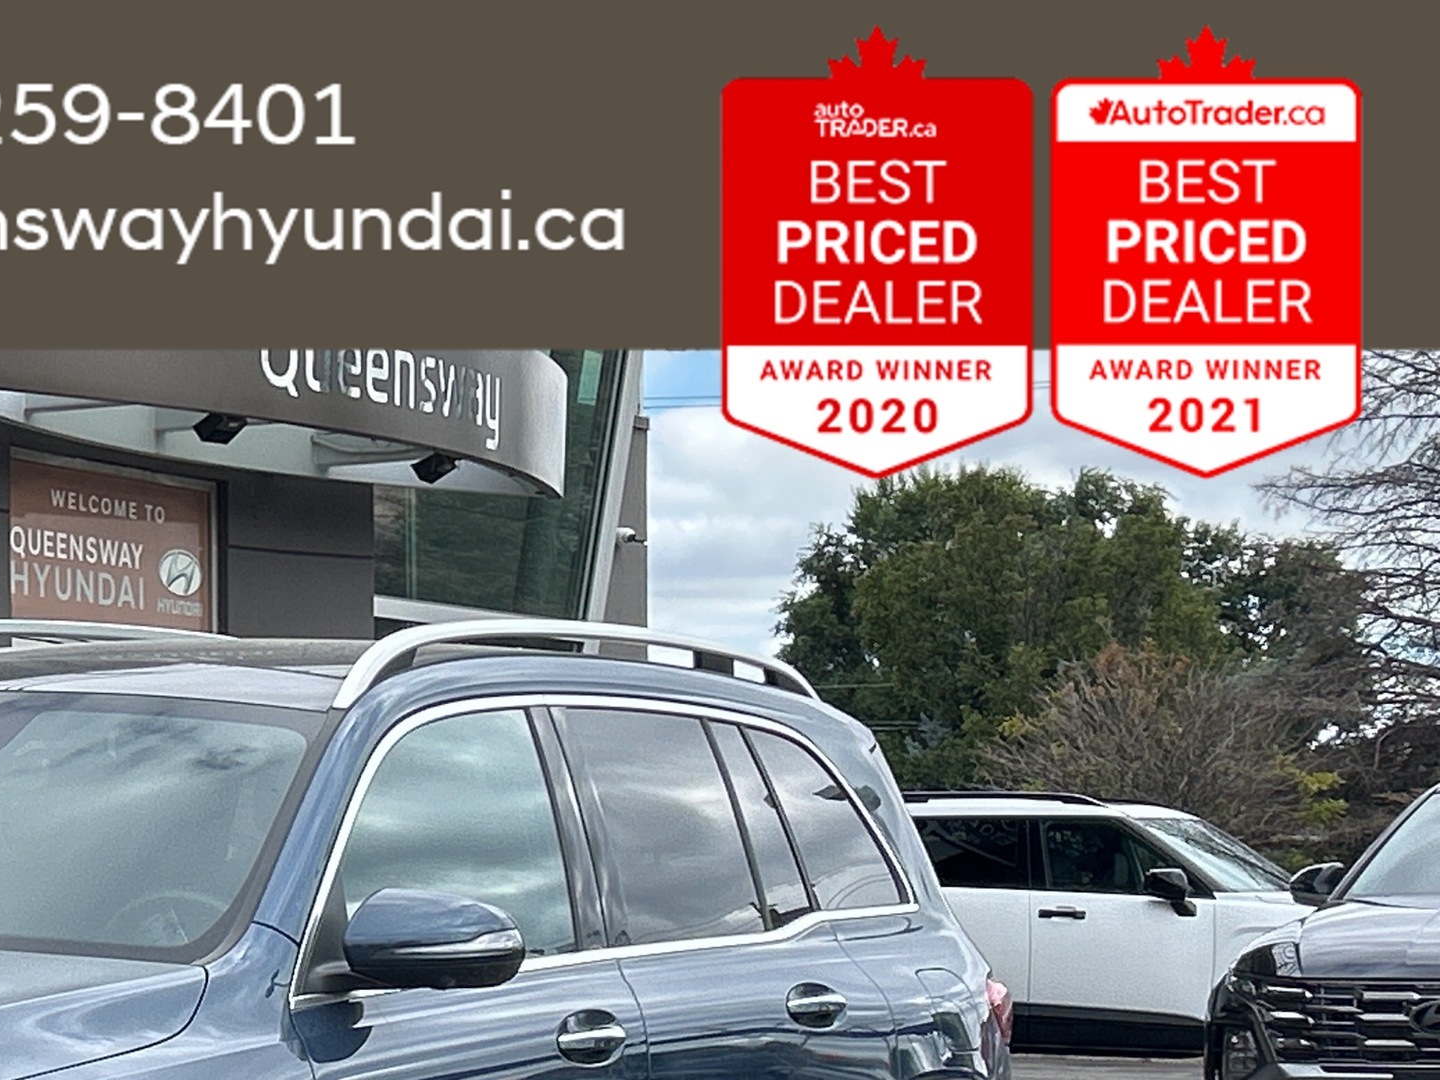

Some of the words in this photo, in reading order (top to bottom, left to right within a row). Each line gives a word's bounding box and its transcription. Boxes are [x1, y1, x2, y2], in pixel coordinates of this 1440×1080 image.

[50, 488, 138, 520] WELCOME
[145, 504, 166, 524] TO
[10, 525, 143, 570] QUEENSWAY
[10, 560, 144, 610] HYUNDAI
